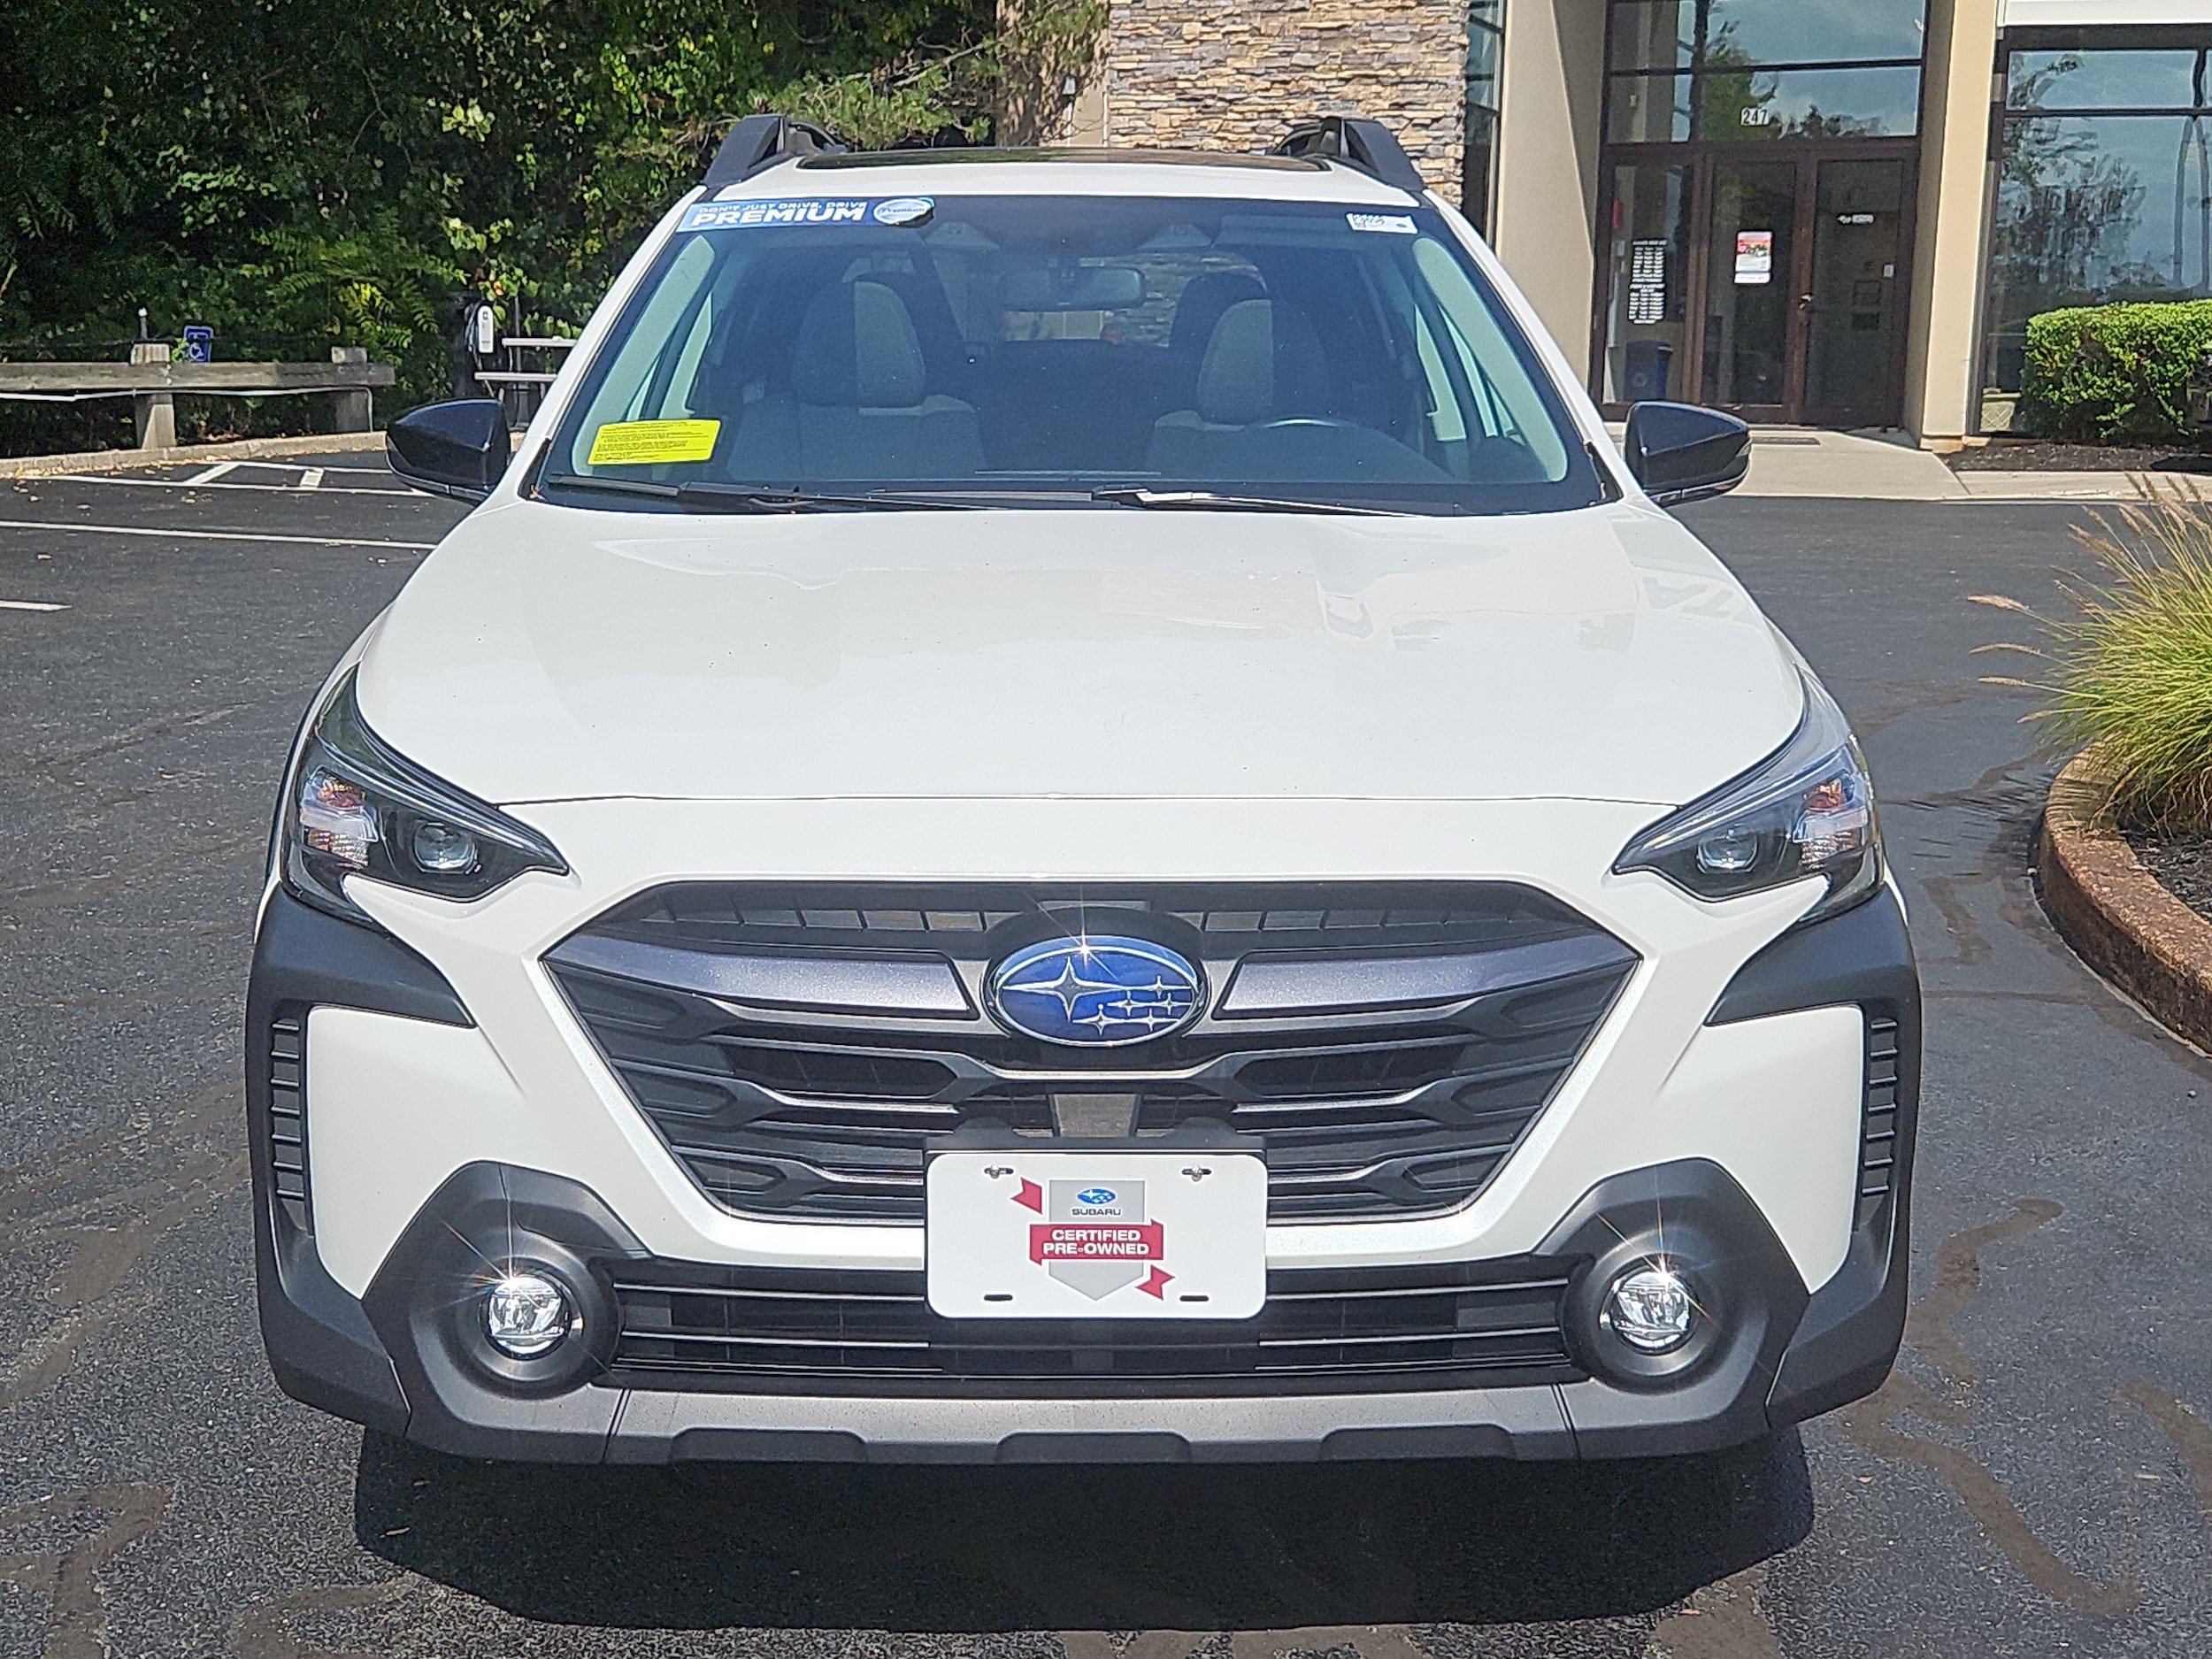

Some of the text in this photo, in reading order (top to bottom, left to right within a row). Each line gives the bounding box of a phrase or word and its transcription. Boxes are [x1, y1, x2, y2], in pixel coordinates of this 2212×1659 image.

[1743, 109, 1768, 125] 247
[742, 203, 777, 211] JUST
[691, 204, 866, 227] PREMIUM
[1051, 1229, 1141, 1241] CERTIFIED
[1043, 1242, 1149, 1255] PRE-OWNED
